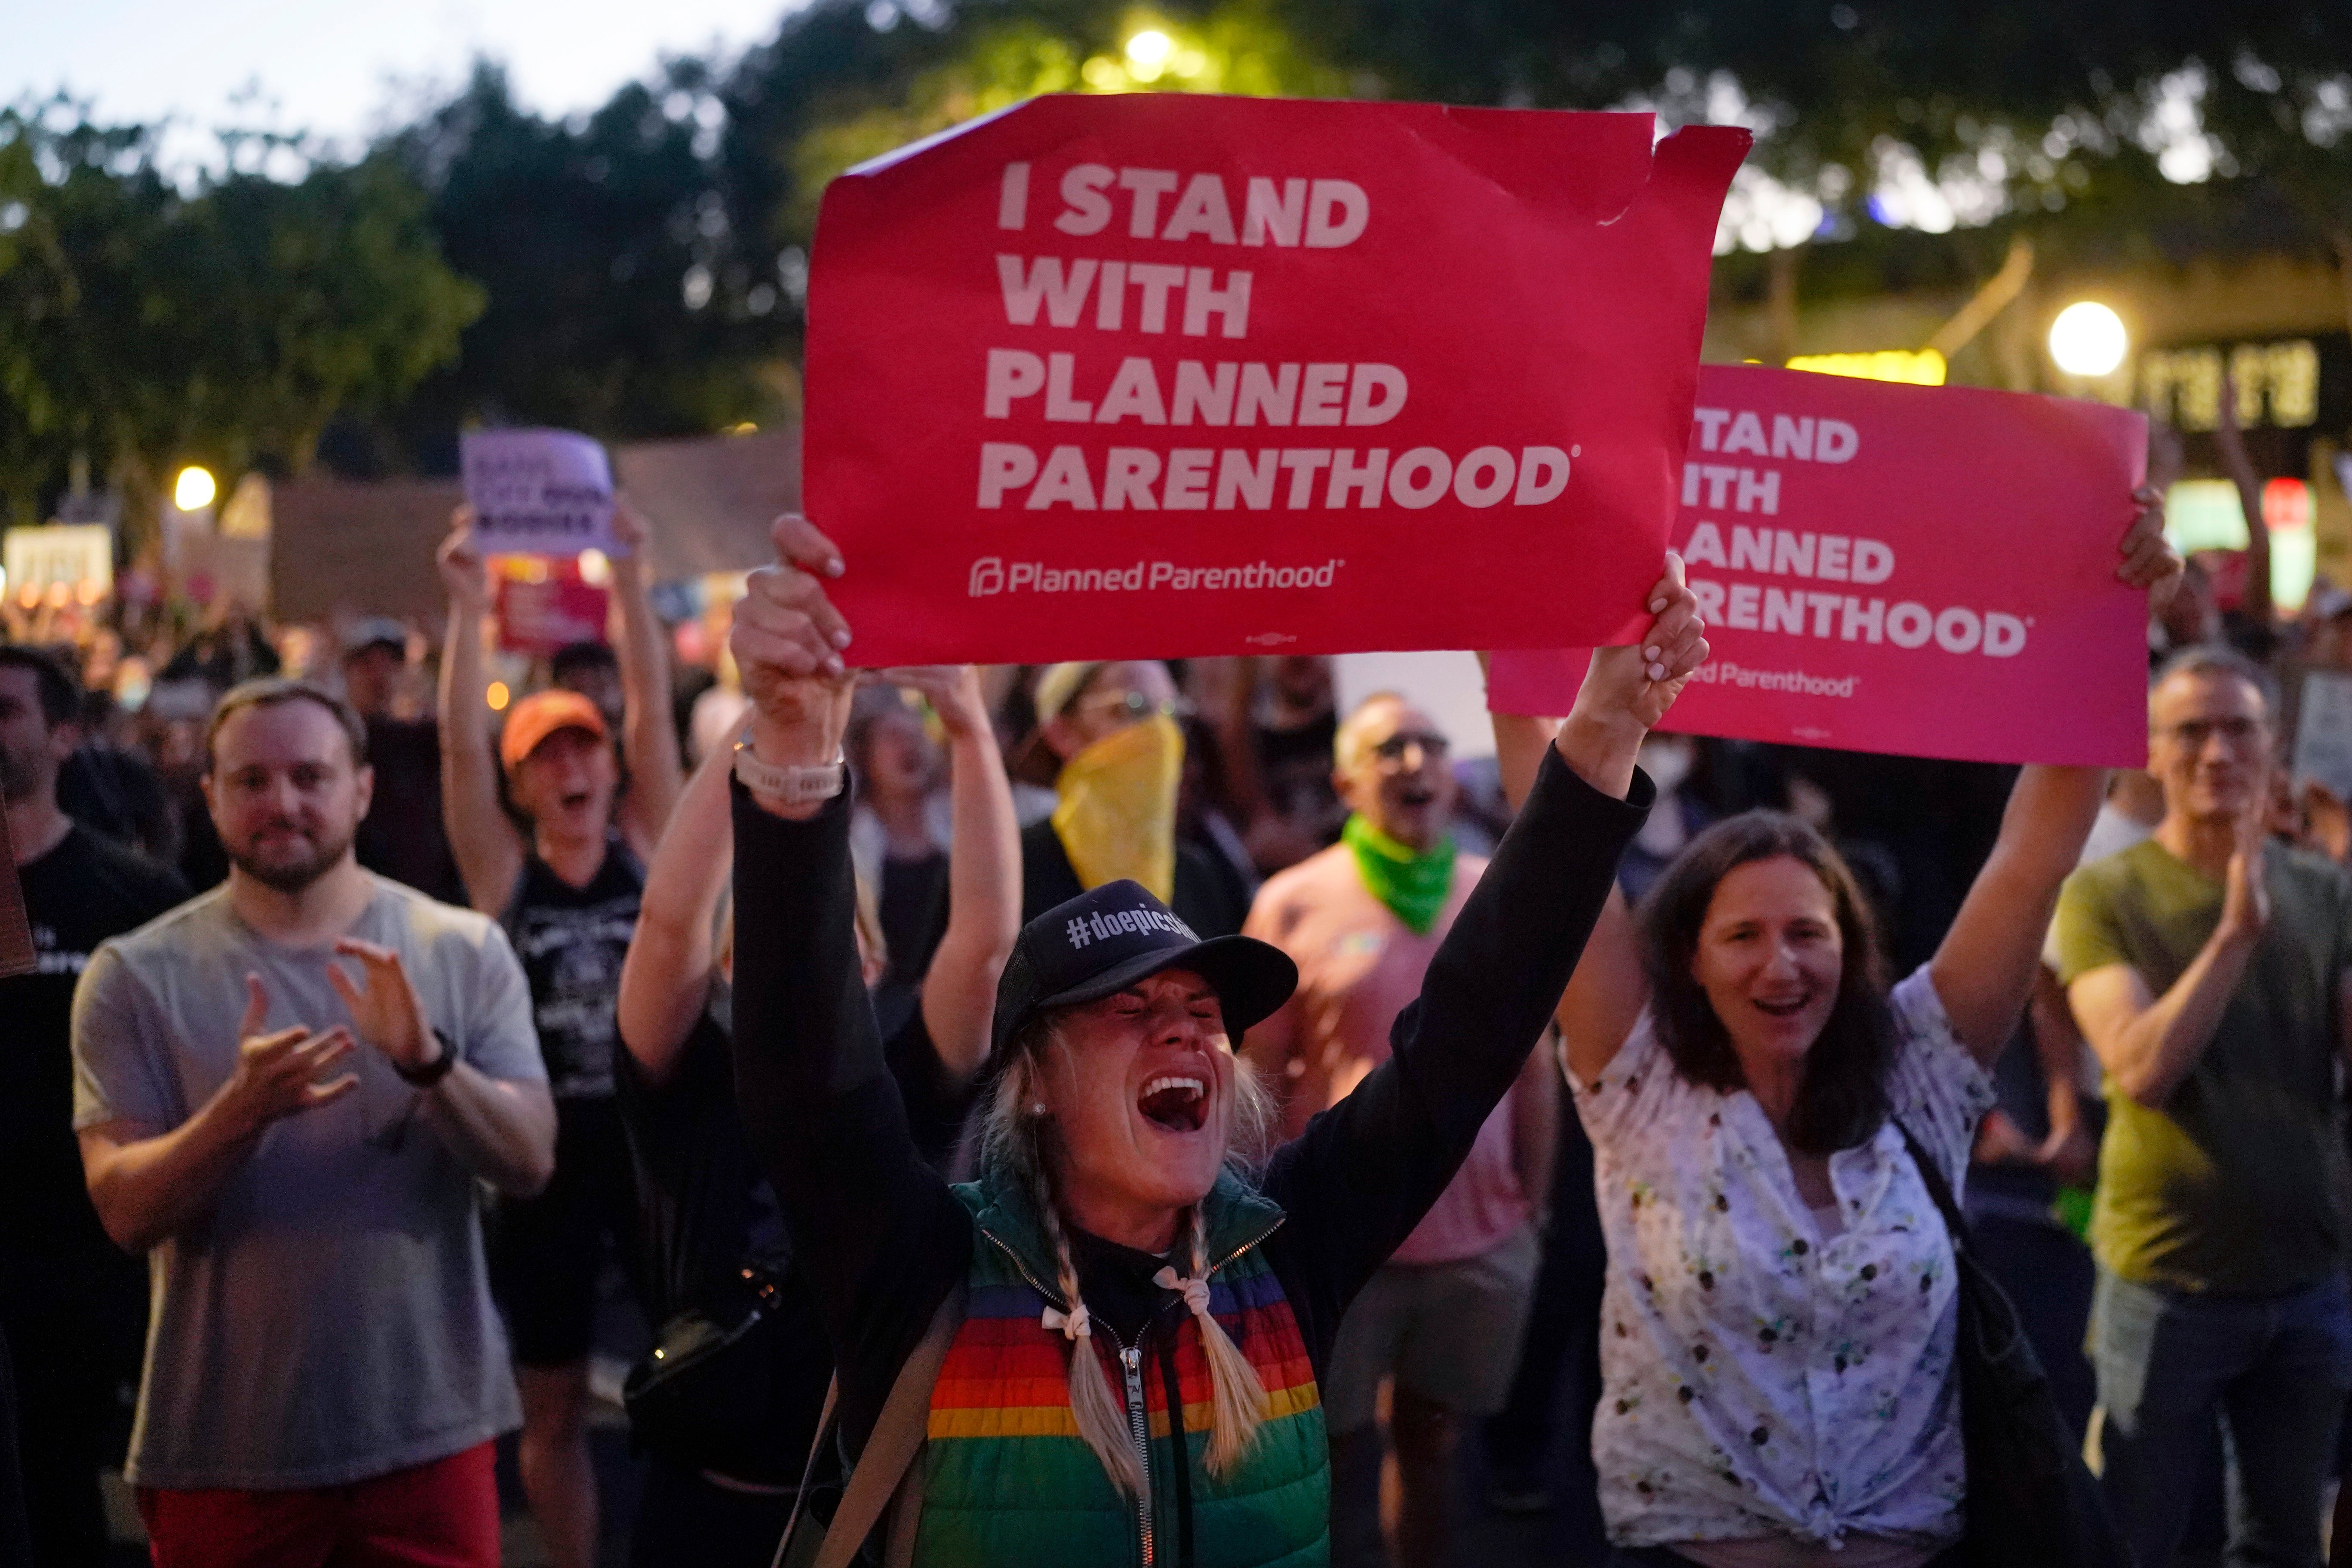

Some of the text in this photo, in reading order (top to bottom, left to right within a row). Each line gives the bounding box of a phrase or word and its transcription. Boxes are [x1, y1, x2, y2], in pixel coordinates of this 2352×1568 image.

[997, 162, 1370, 249] I STAND
[995, 254, 1253, 339] WITH
[984, 348, 1408, 427] PLANNED
[1694, 407, 1860, 464] TAND
[1681, 462, 1781, 516] ITH
[1008, 559, 1336, 593] Planned Parenthood
[1673, 521, 1895, 585] ANNED
[1688, 579, 2028, 658] RENTHOOD
[1721, 662, 1854, 698] Parenthood
